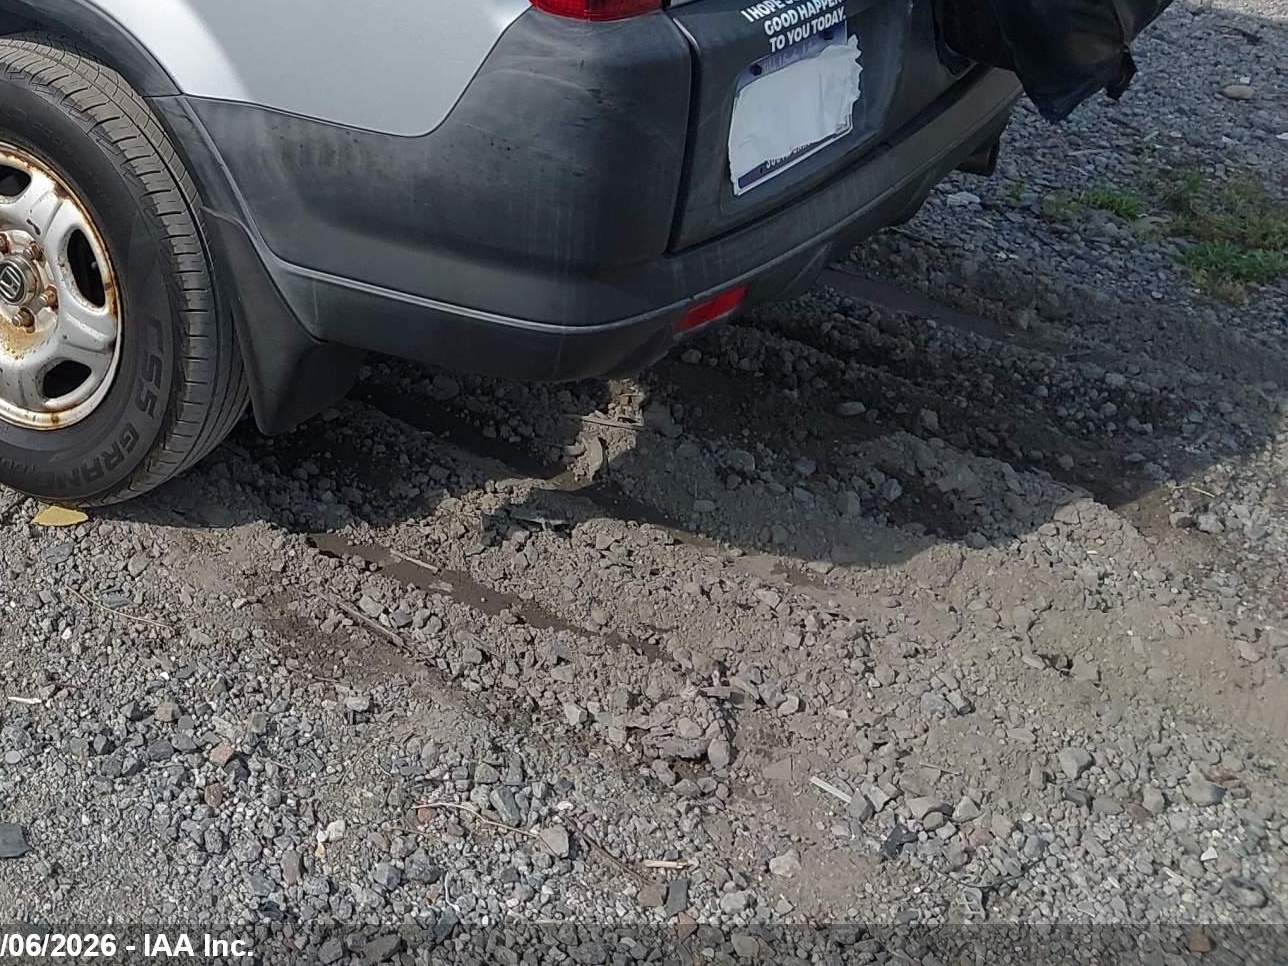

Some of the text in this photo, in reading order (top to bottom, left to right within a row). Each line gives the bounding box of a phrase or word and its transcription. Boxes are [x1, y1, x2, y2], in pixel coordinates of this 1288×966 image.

[741, 10, 754, 23] I
[764, 9, 798, 36] GOOD
[769, 6, 847, 53] TO YOU TODAY.
